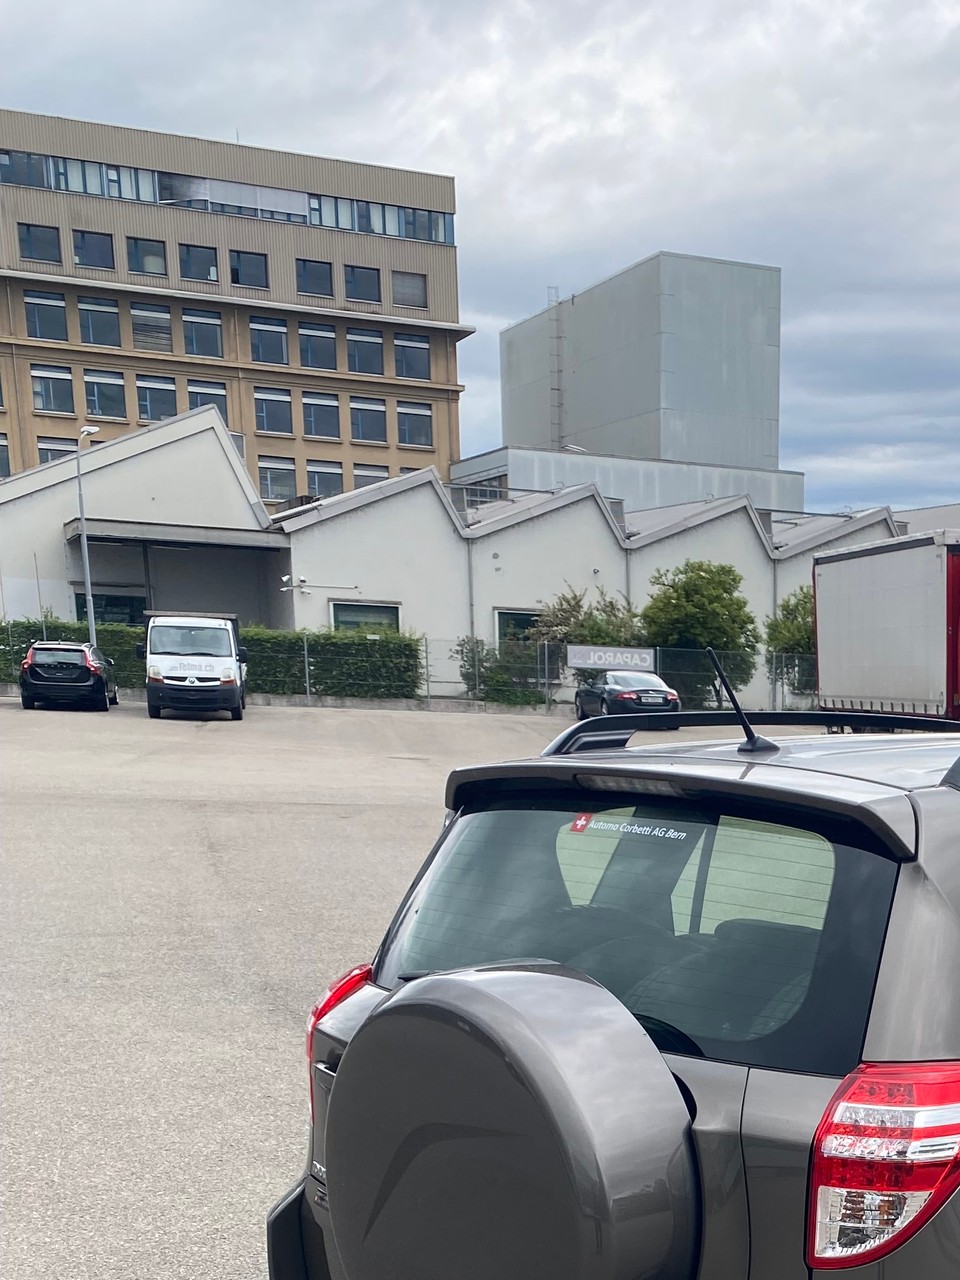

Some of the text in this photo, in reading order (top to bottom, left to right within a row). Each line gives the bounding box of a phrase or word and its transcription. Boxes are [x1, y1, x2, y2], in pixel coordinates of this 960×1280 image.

[588, 819, 687, 840] Automo Corbetti AG Bern
